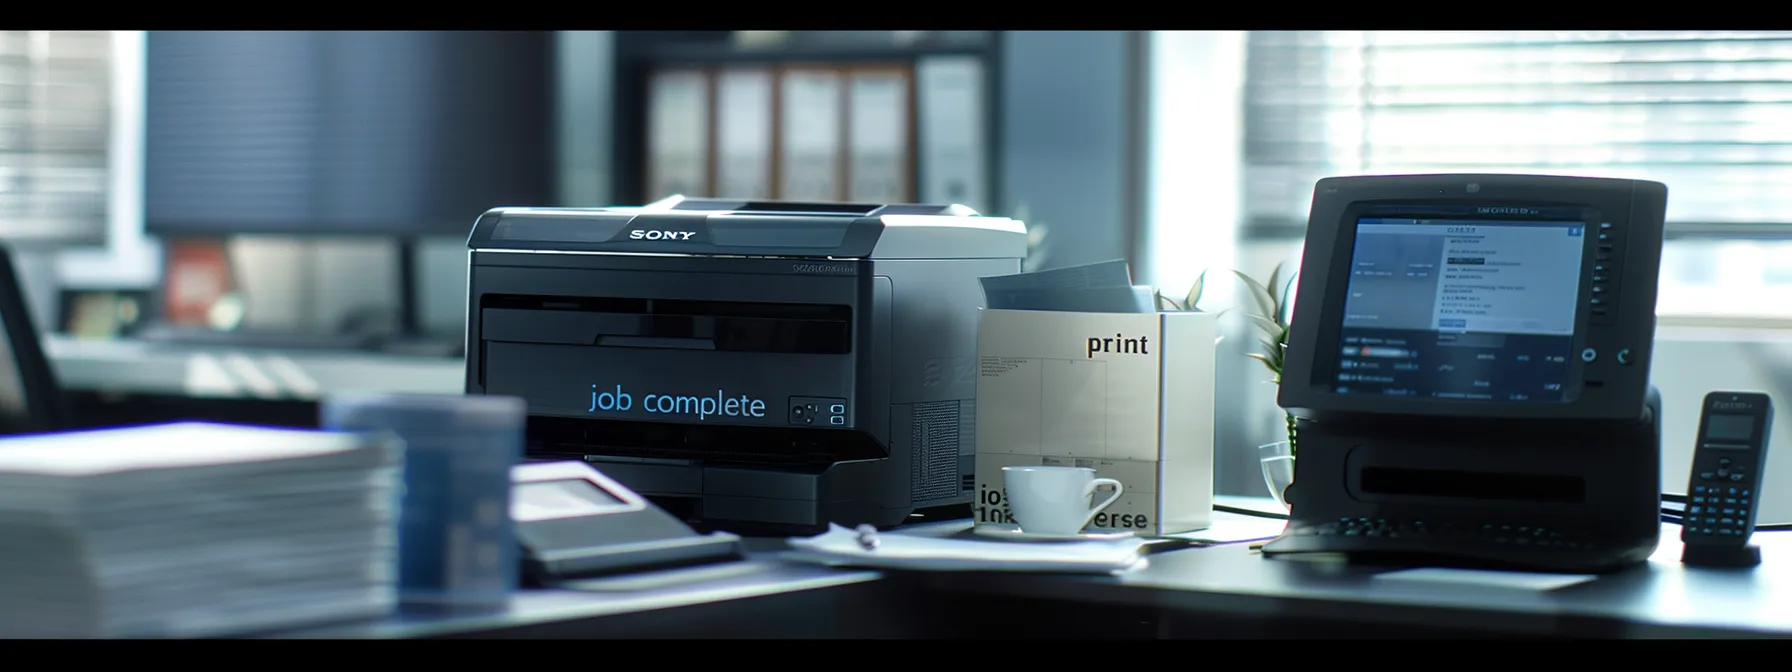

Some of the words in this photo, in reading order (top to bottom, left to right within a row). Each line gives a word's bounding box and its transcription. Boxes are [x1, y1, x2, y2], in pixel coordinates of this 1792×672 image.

[630, 230, 696, 241] SONY
[1087, 334, 1148, 358] print
[589, 384, 632, 413] job
[644, 390, 765, 421] complete
[980, 483, 1008, 506] io
[1094, 511, 1148, 529] erse
